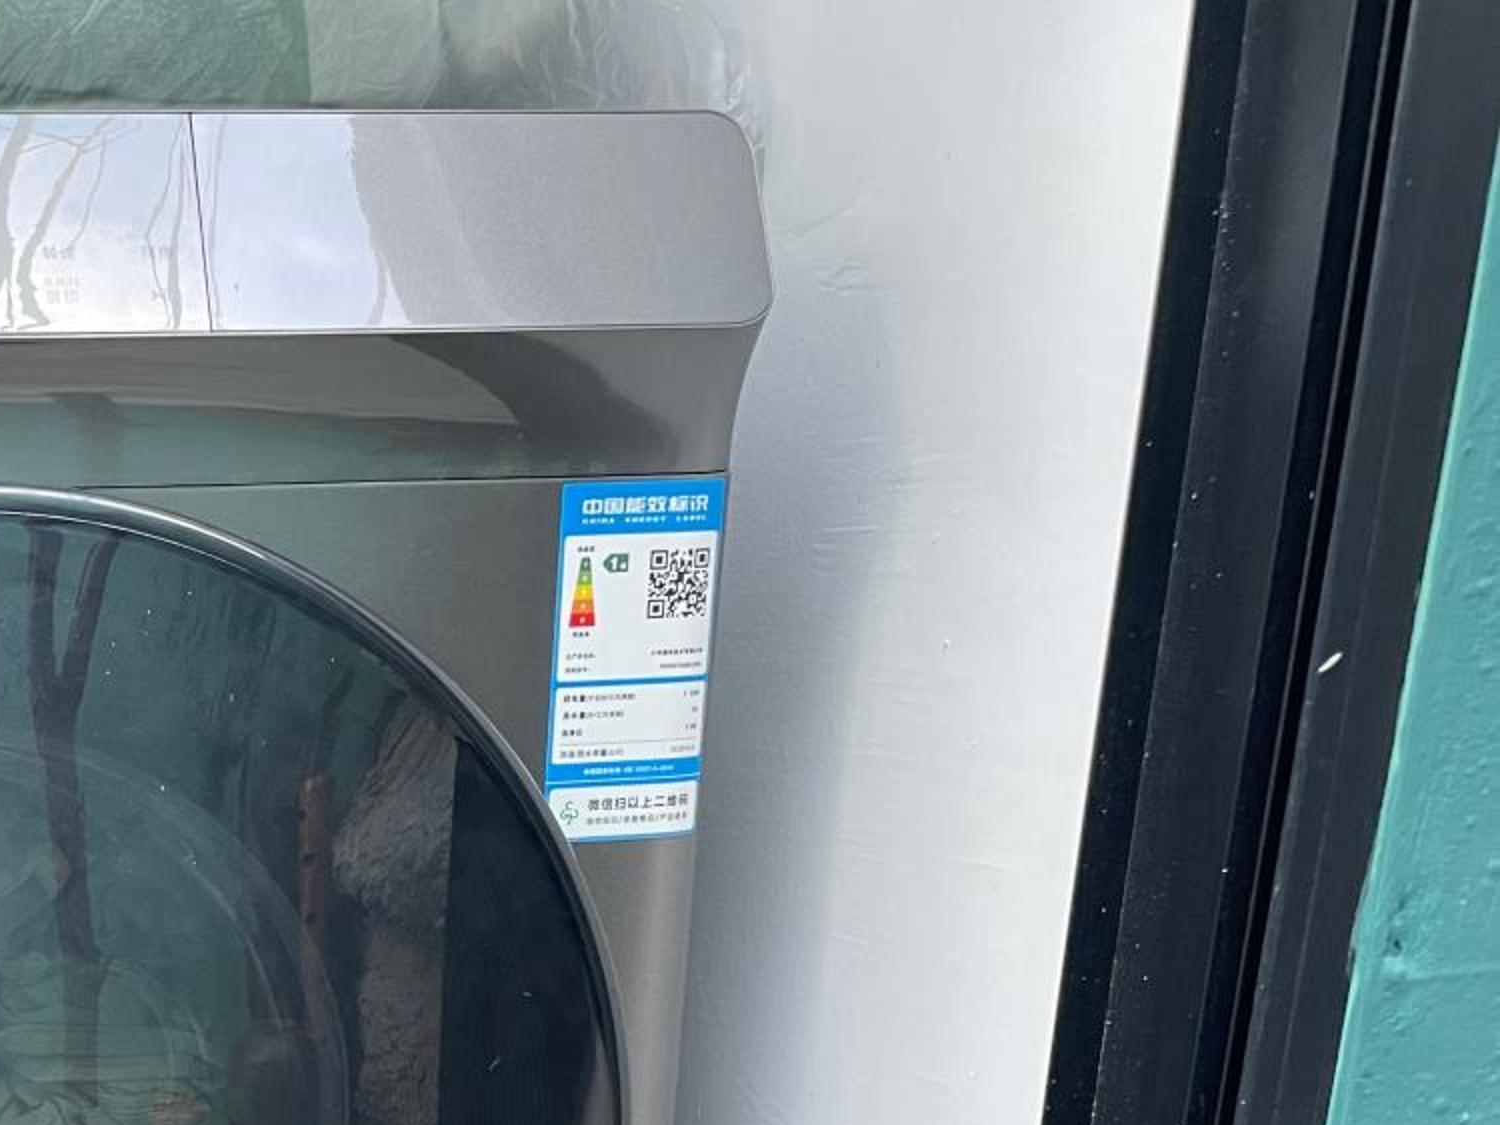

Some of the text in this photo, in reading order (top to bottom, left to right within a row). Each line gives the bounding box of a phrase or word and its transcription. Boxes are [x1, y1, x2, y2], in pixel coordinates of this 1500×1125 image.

[582, 494, 709, 515] 中国能效标识
[587, 793, 689, 811] 微信扫以上二维码
